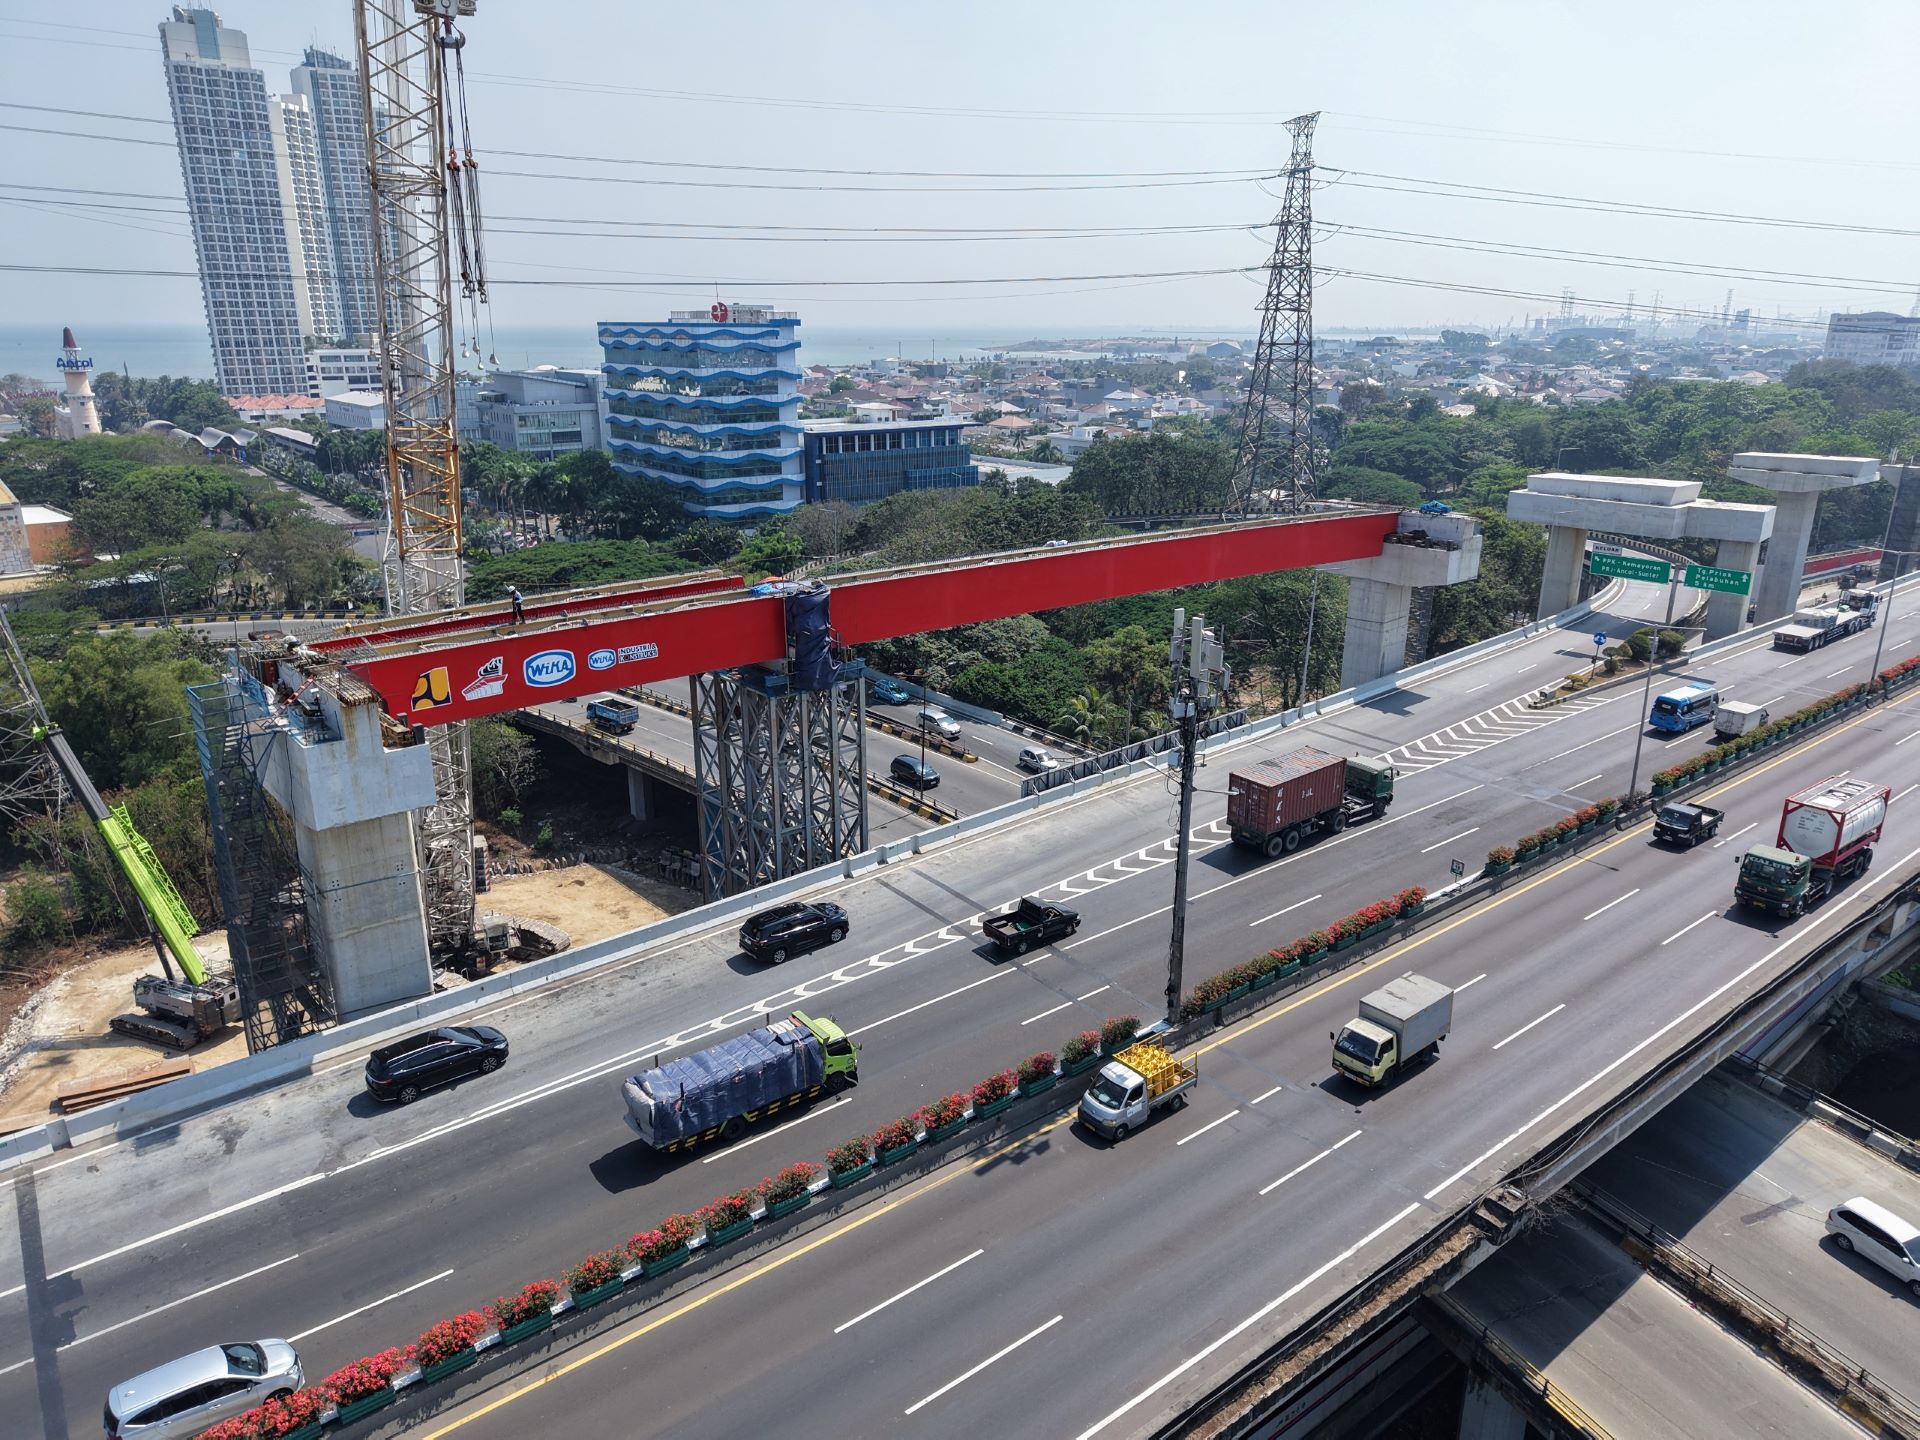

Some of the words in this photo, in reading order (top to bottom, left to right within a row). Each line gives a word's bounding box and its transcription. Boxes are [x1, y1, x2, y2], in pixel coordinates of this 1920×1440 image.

[1622, 560, 1662, 571] Kemayoran
[1695, 574, 1739, 586] Pelabuhan
[618, 644, 650, 655] INDUSTRI
